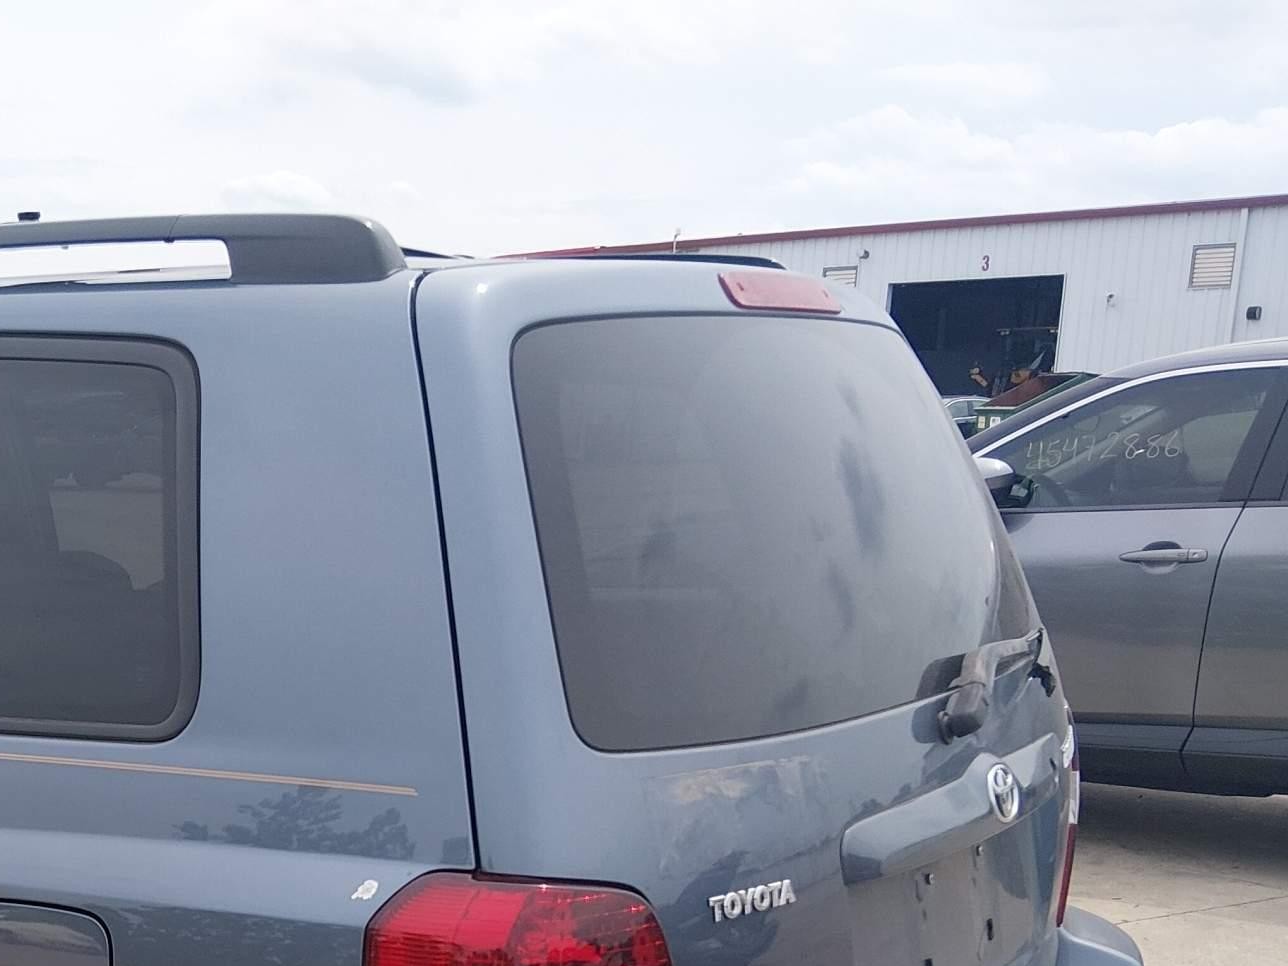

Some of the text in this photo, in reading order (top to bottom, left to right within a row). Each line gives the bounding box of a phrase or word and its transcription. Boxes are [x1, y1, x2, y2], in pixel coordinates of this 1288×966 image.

[982, 255, 990, 271] 3
[1026, 431, 1180, 470] 45472886
[709, 879, 796, 922] TOYOTA
